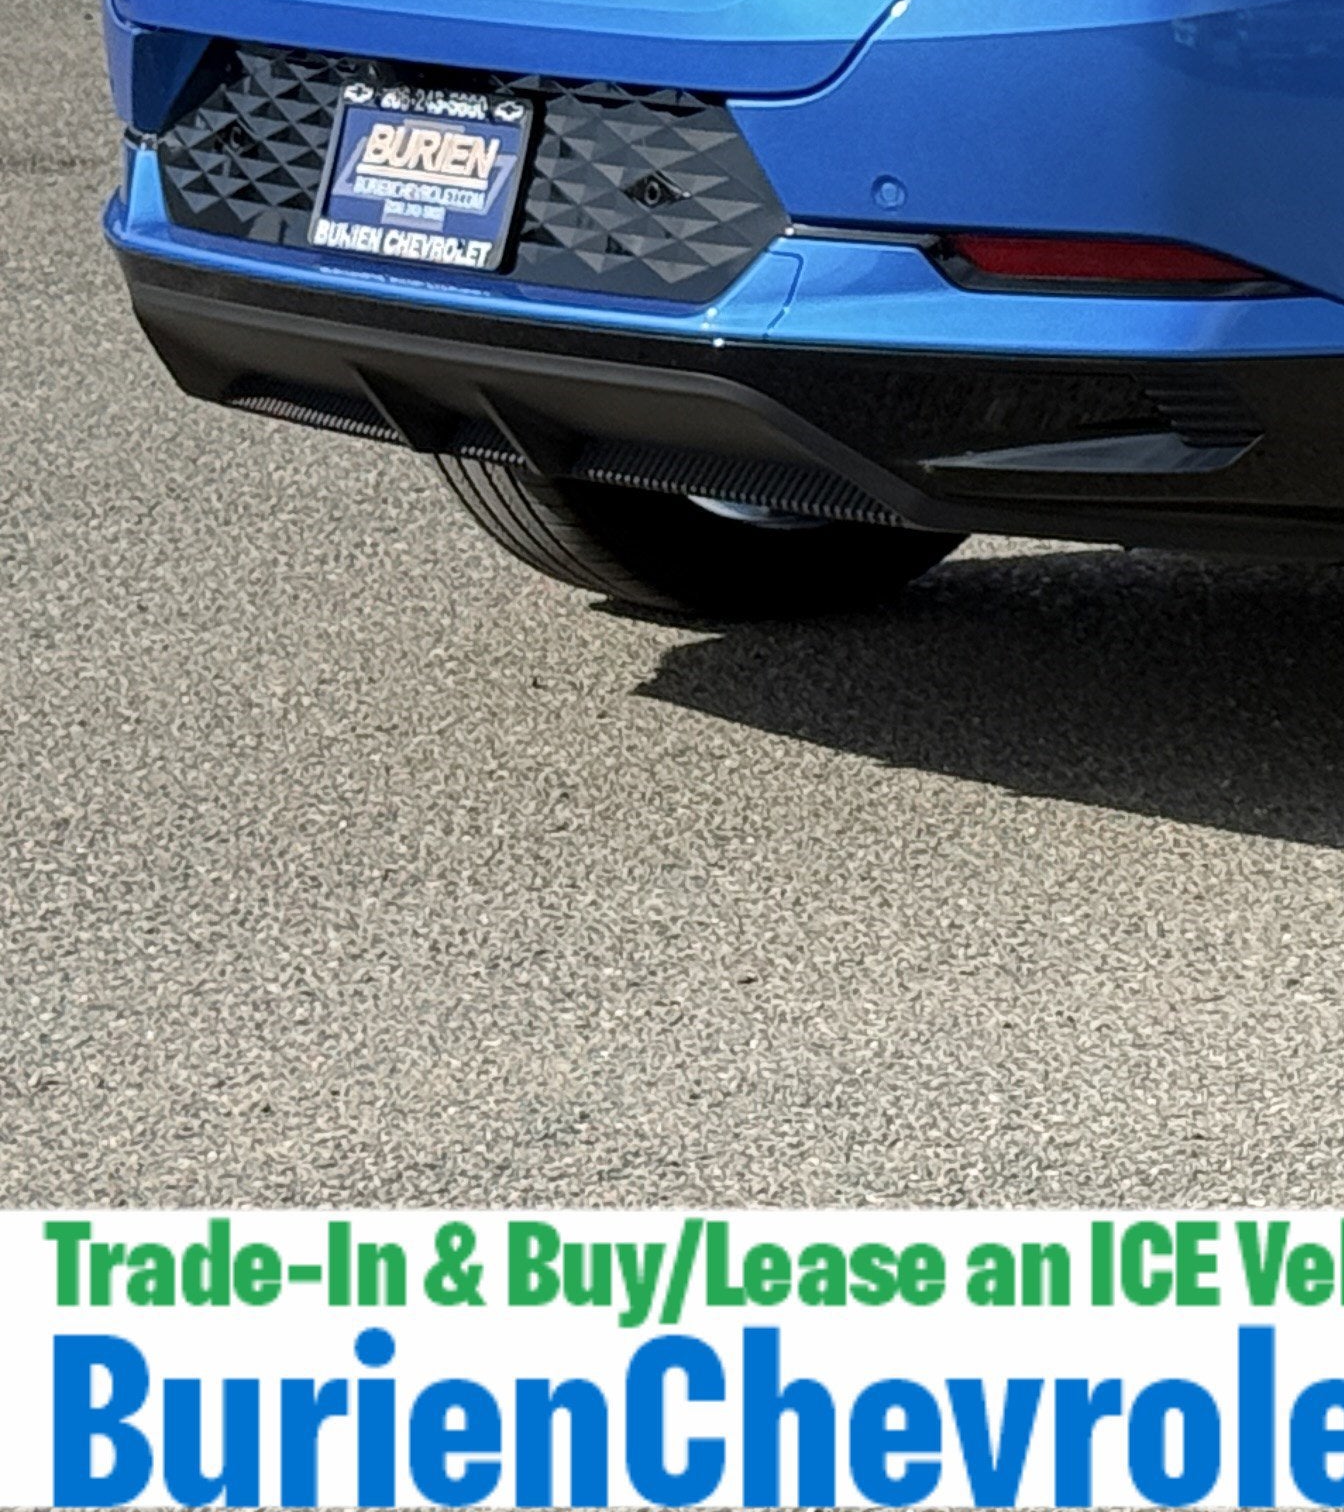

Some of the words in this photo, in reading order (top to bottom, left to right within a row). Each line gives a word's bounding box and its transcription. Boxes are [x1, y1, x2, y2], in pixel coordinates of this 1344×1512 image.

[363, 123, 500, 178] BURIEN
[313, 218, 383, 254] BURIEN
[383, 229, 492, 268] CHEVROLET
